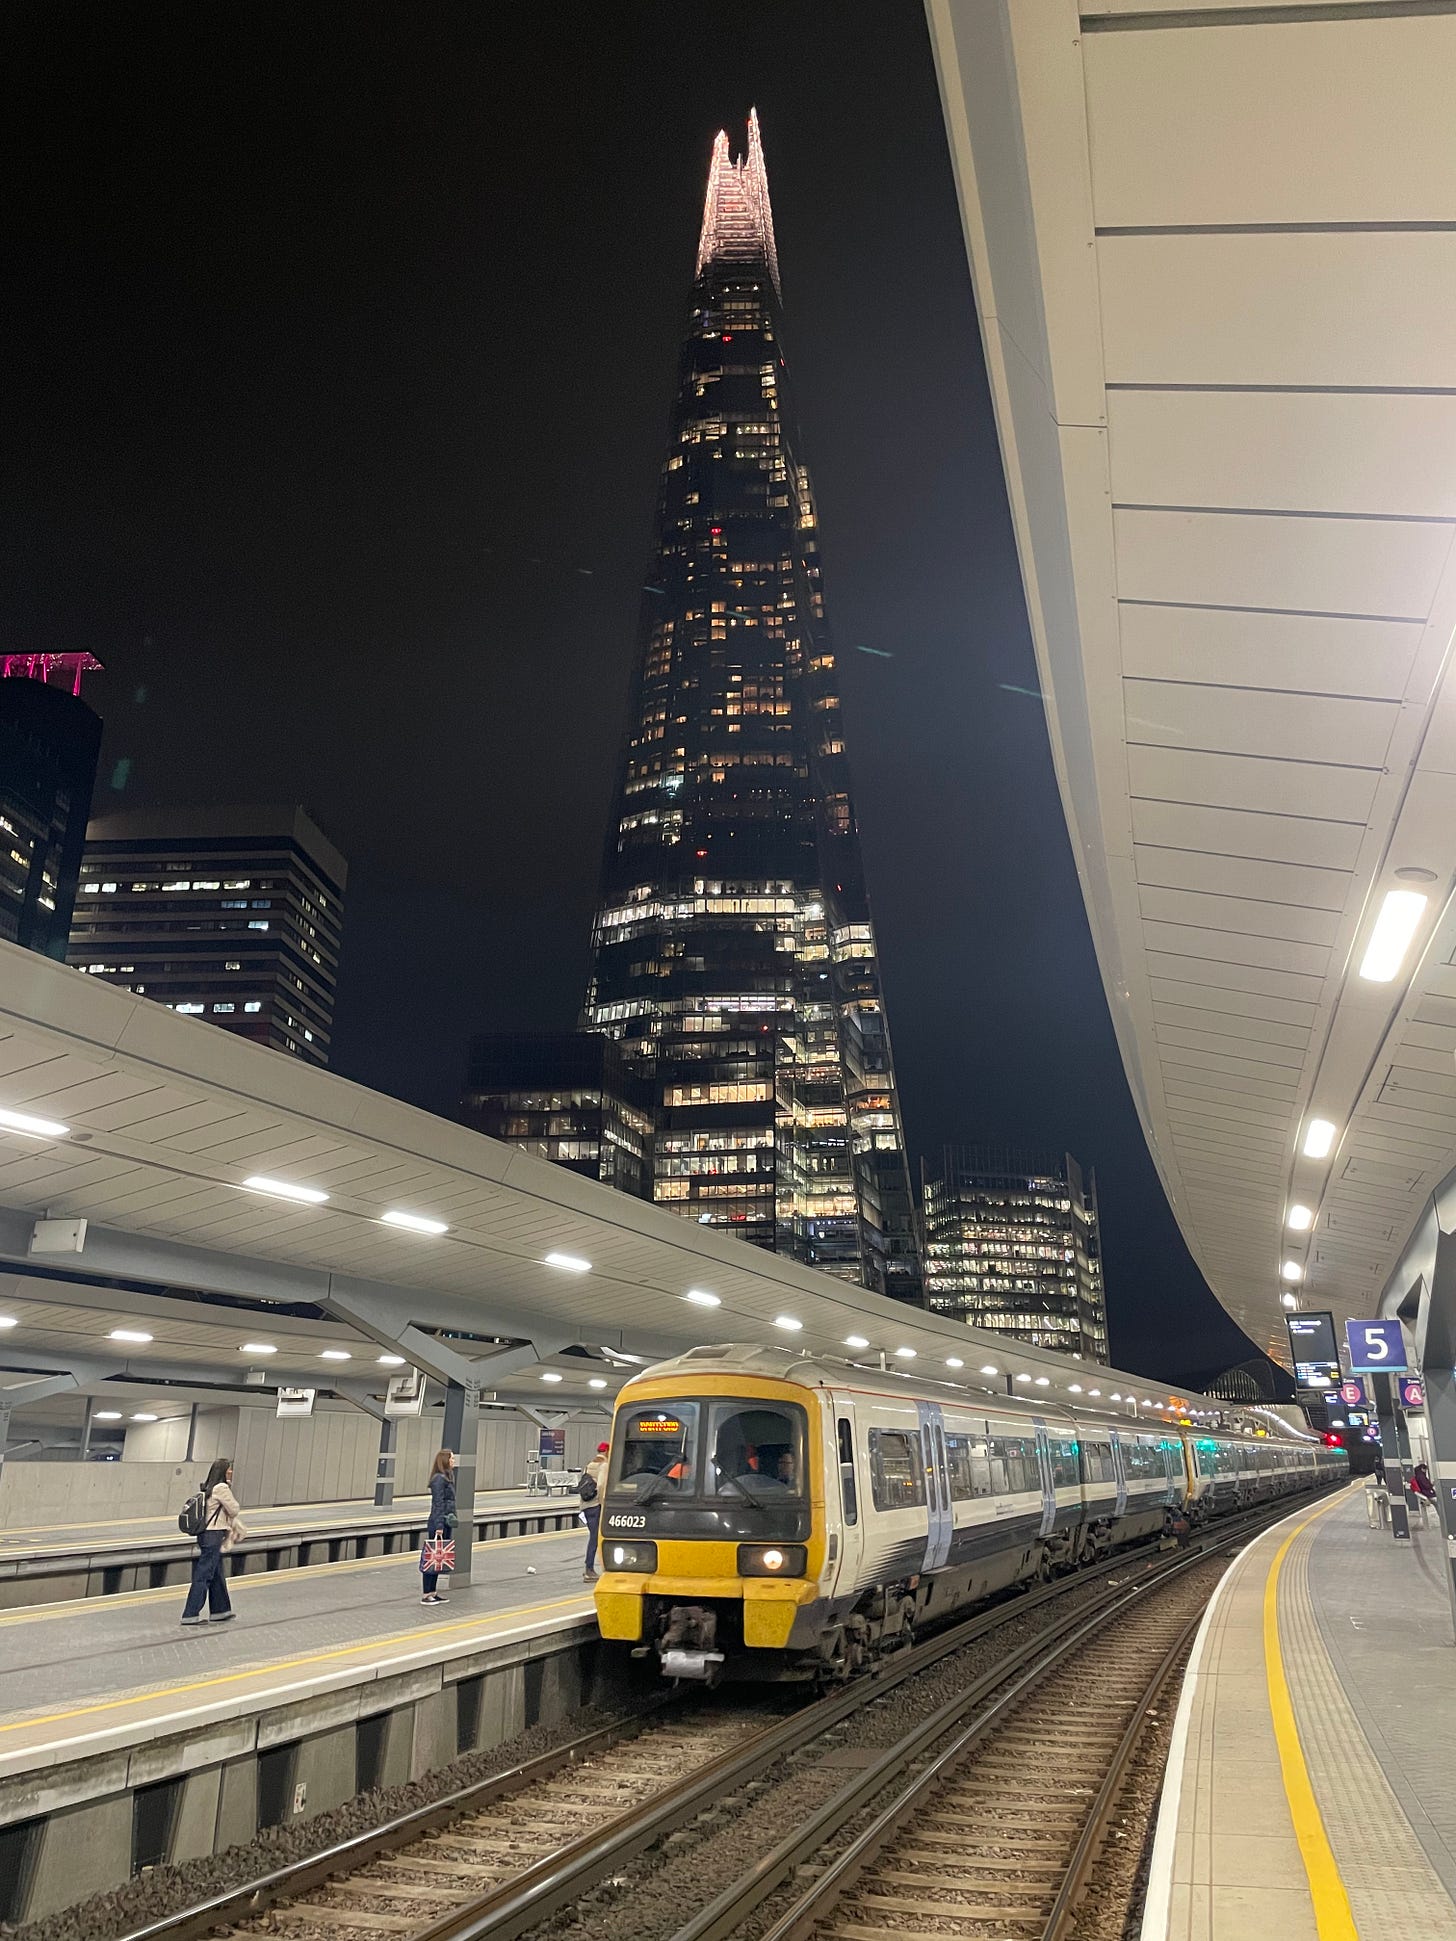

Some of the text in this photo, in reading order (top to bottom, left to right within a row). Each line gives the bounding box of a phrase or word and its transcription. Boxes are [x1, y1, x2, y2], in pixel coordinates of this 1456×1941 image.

[1365, 1328, 1389, 1360] 5
[1346, 1387, 1356, 1399] E
[1410, 1388, 1422, 1400] A
[608, 1515, 646, 1528] 466023
